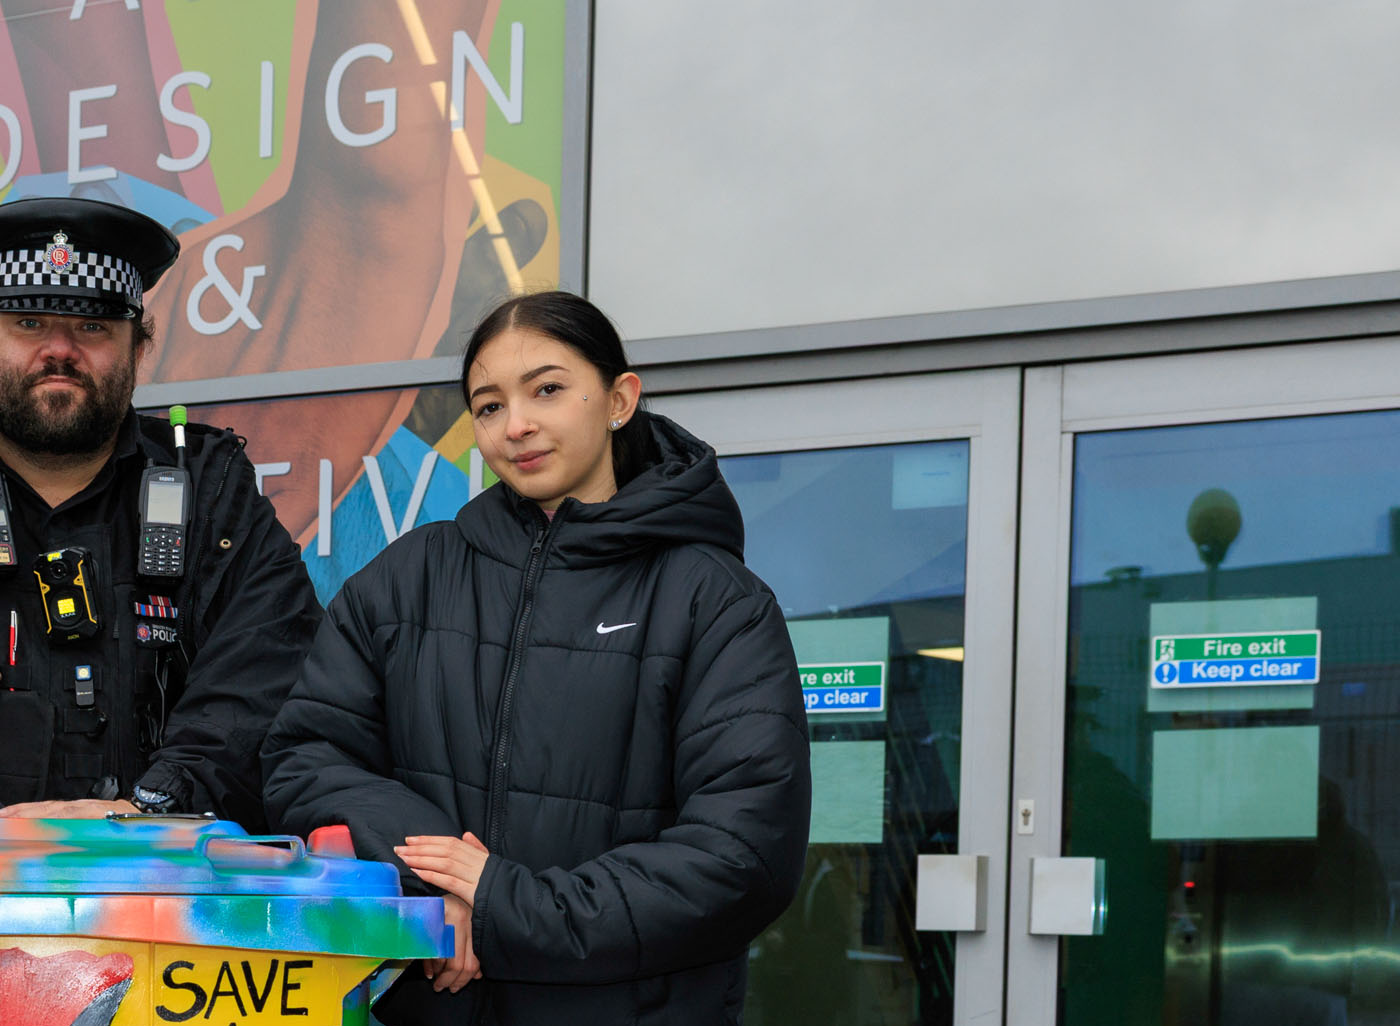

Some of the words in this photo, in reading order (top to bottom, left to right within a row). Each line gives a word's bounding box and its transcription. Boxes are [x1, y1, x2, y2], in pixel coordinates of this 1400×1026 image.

[186, 234, 266, 335] &
[152, 628, 177, 643] POLIC
[1203, 639, 1243, 657] Fire
[1248, 638, 1286, 655] exit
[822, 669, 855, 685] exit
[1192, 661, 1244, 681] Keep
[1250, 660, 1302, 677] clear
[824, 689, 868, 705] clear
[156, 959, 313, 1021] SAVE
